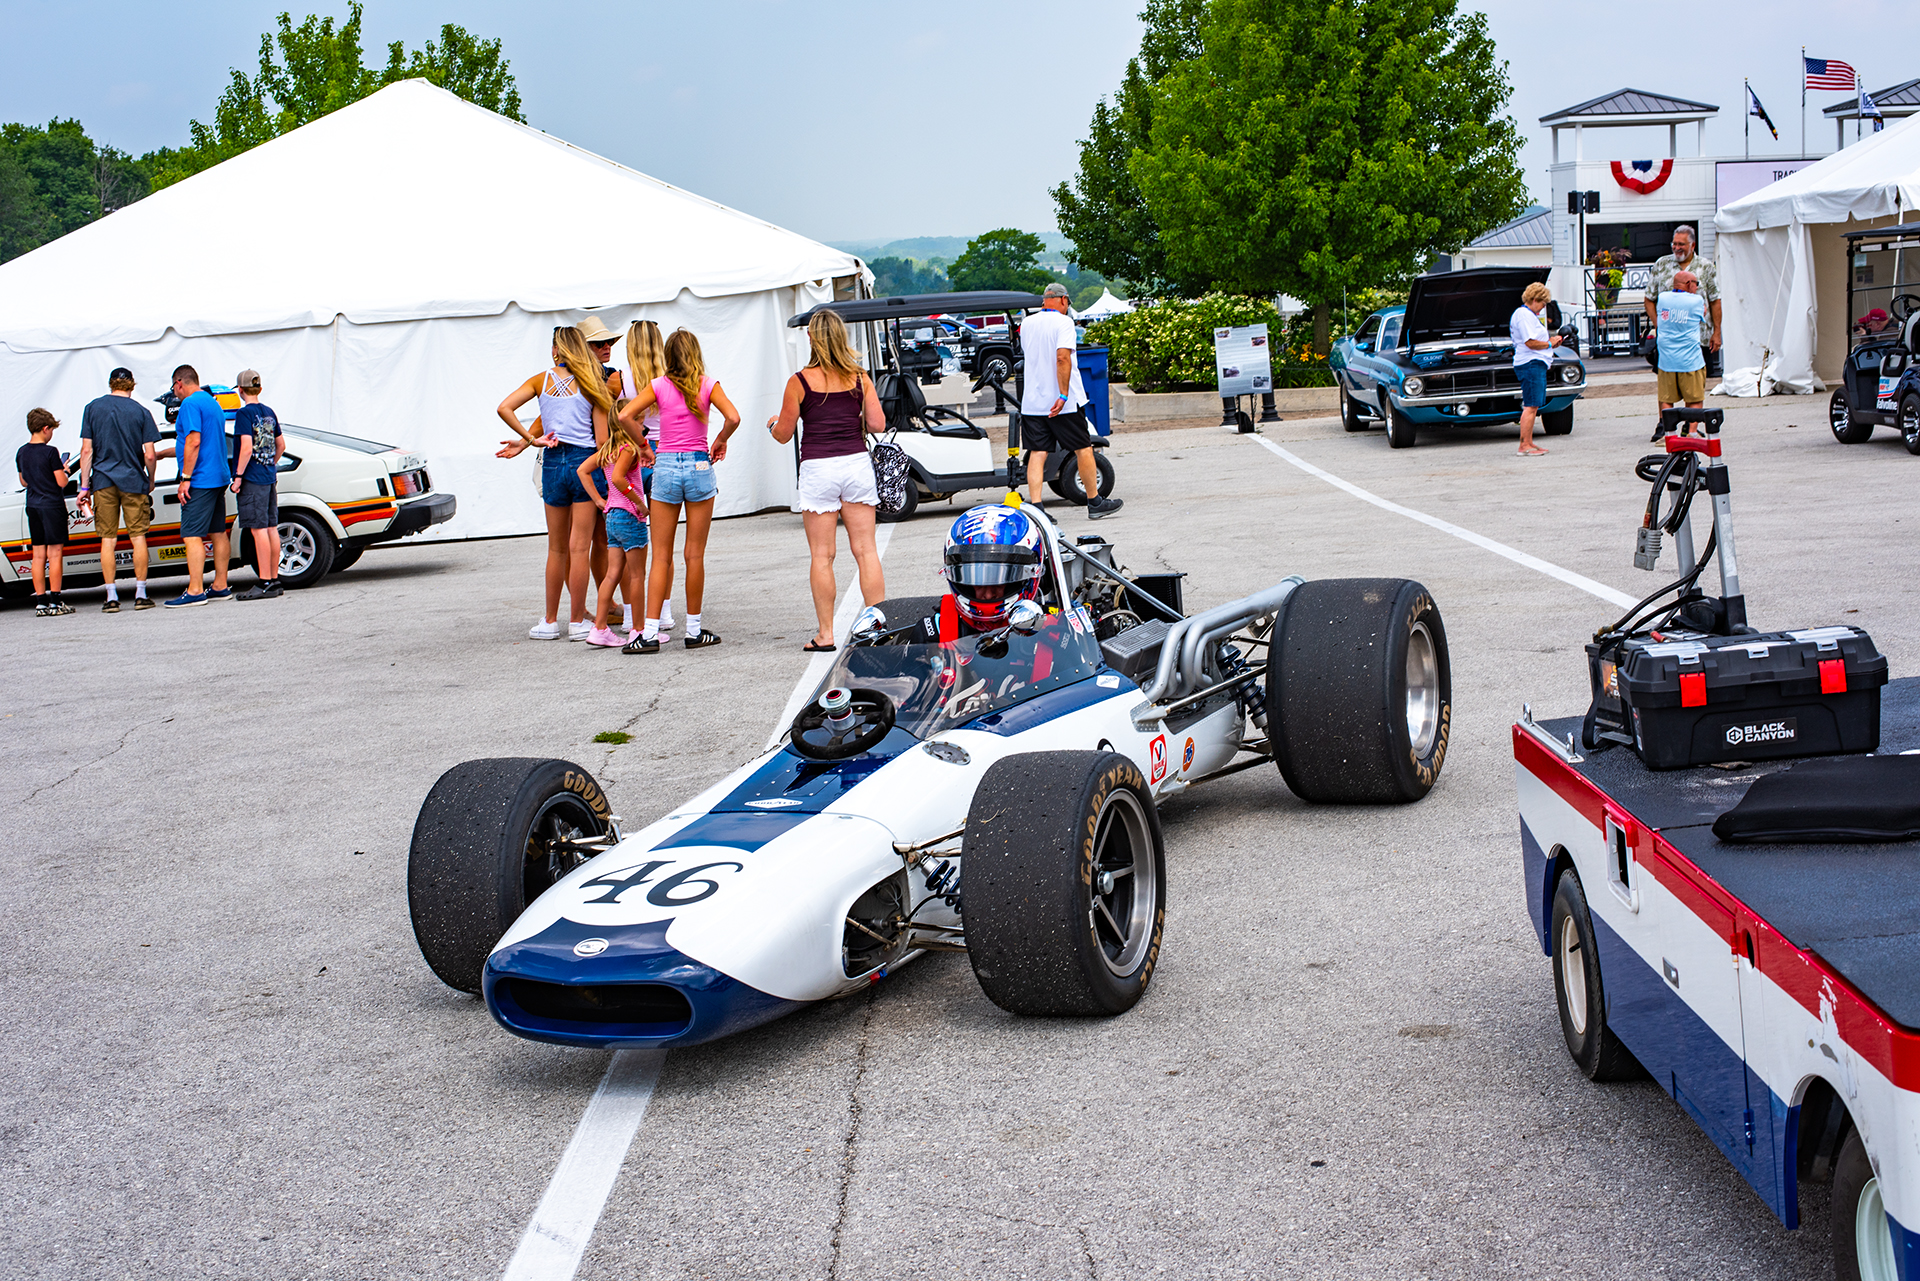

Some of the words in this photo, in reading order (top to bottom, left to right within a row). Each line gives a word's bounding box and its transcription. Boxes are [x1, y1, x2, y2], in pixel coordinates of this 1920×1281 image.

[1772, 168, 1799, 182] TRA
[1744, 721, 1786, 734] BLACK
[1744, 728, 1795, 743] CANYON
[563, 770, 611, 822] GOODY
[578, 860, 744, 907] 46
